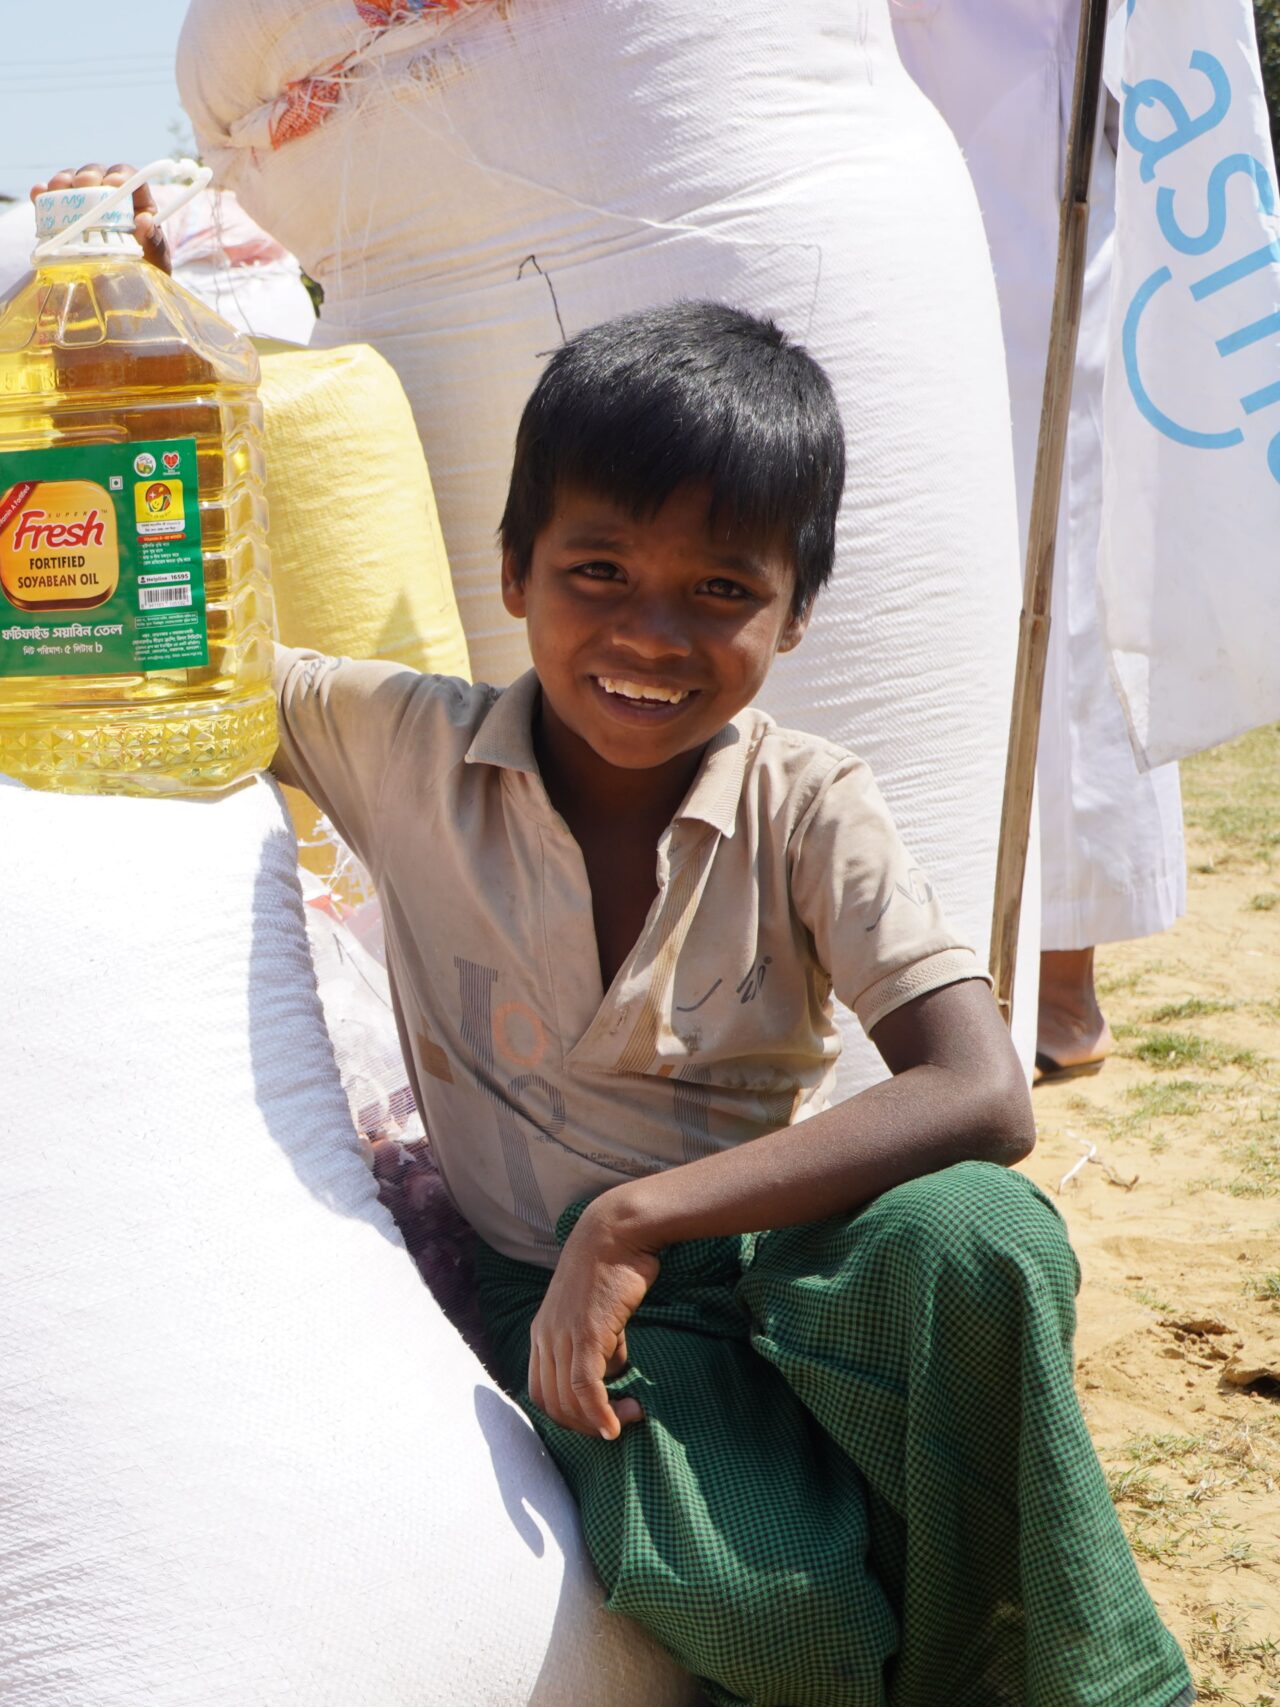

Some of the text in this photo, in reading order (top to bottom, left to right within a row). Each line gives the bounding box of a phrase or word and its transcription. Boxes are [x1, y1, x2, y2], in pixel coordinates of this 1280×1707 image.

[12, 508, 106, 552] Fresh
[29, 555, 86, 570] FORTIFIED
[17, 572, 100, 588] SOYABEAN OIL
[94, 624, 123, 637] তেল
